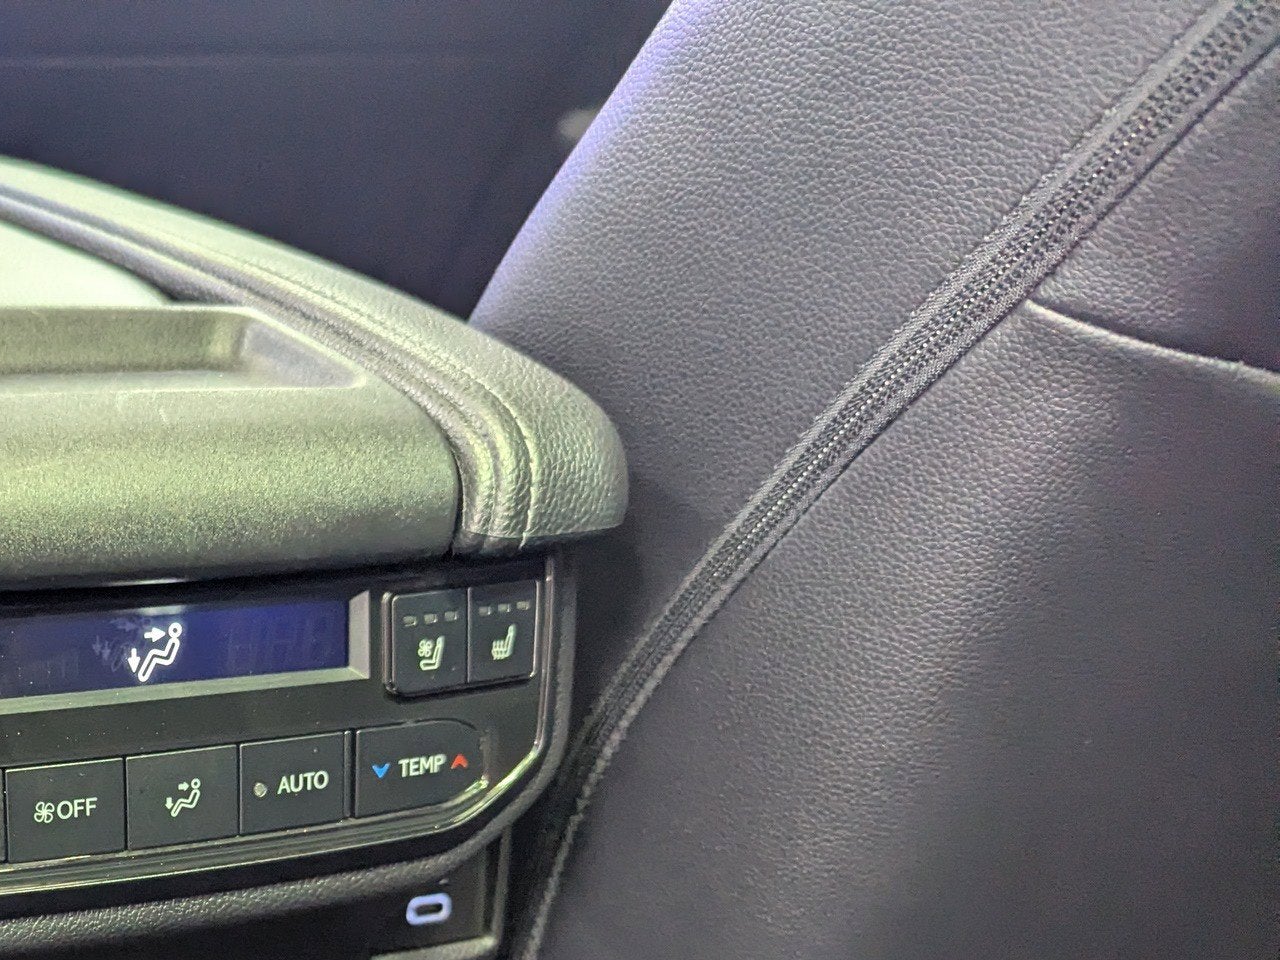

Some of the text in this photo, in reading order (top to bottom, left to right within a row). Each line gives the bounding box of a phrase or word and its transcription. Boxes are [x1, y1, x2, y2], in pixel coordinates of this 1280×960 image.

[398, 754, 447, 777] TEMP
[277, 770, 329, 794] AUTO
[57, 797, 98, 819] OFF
